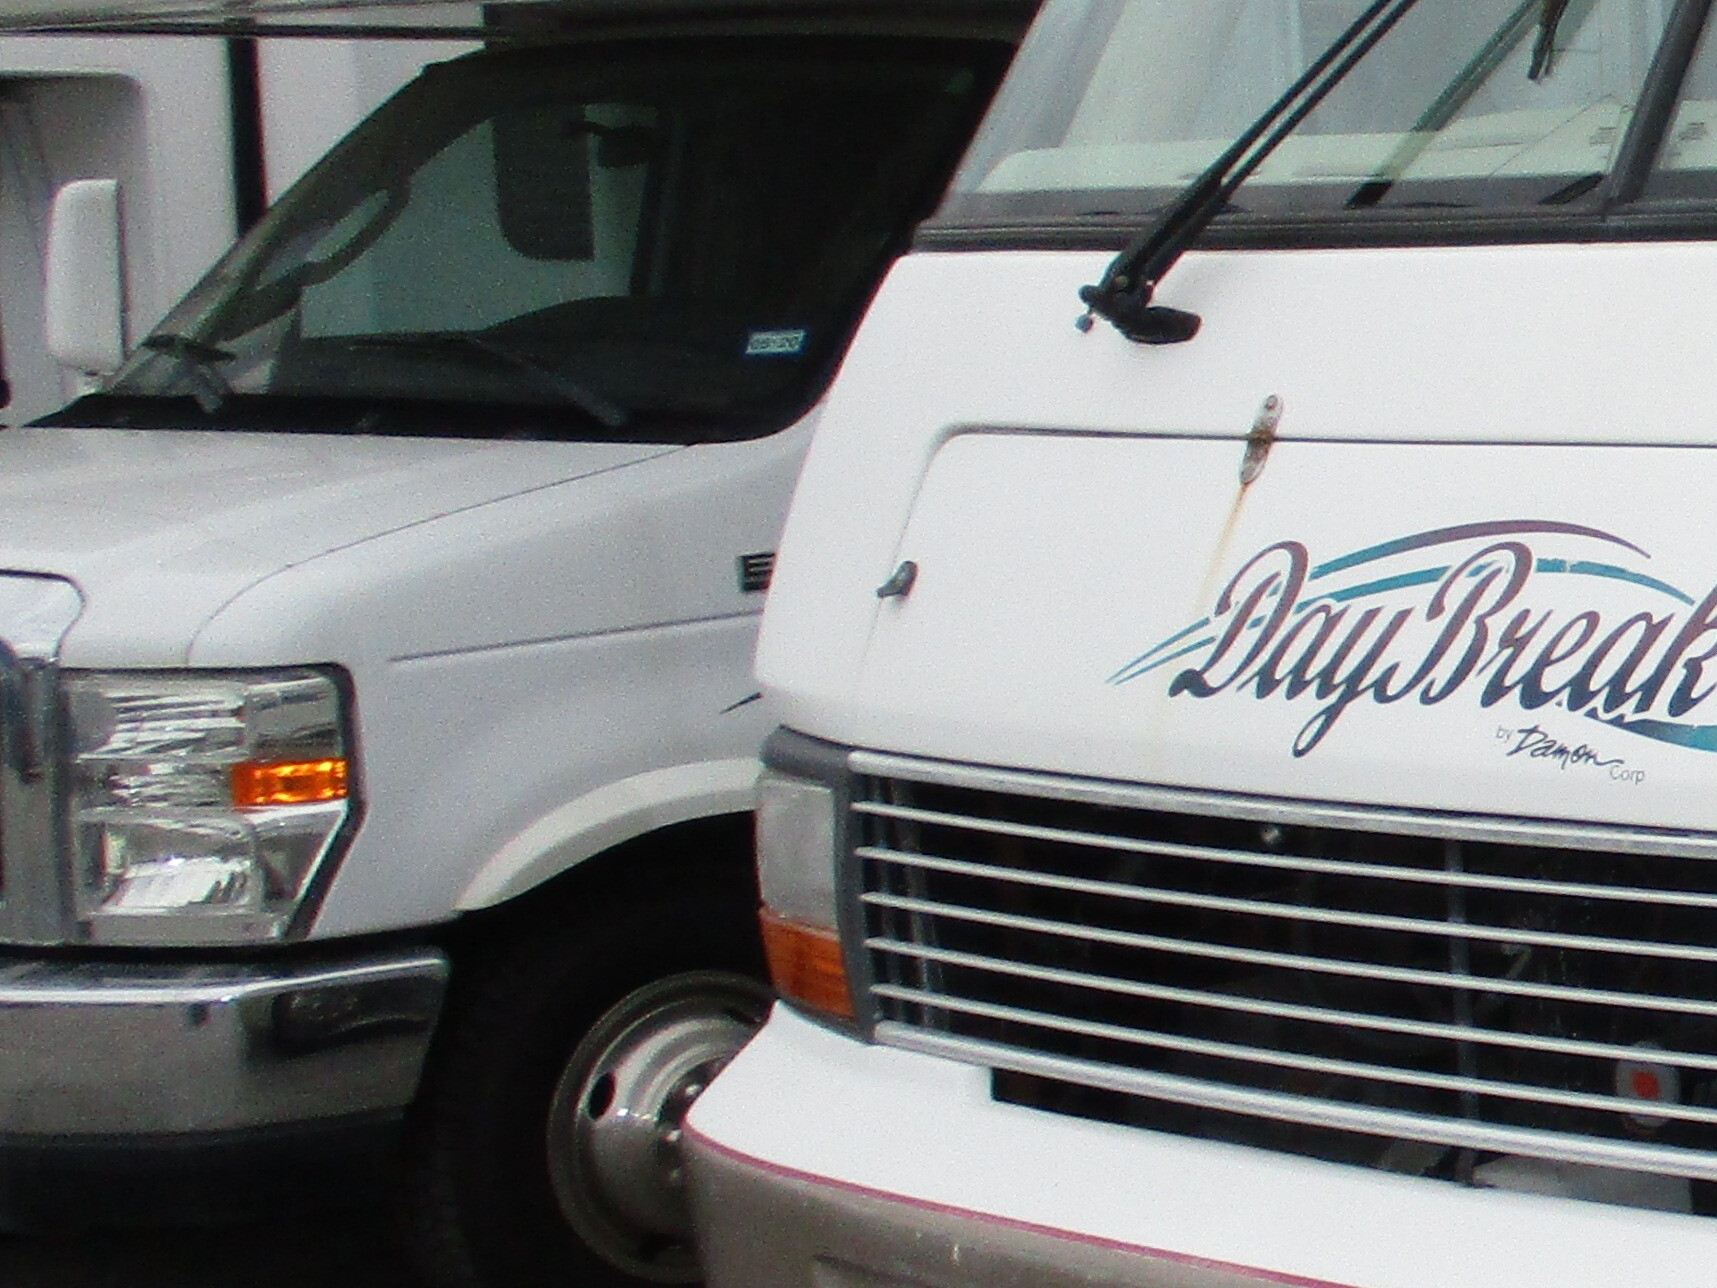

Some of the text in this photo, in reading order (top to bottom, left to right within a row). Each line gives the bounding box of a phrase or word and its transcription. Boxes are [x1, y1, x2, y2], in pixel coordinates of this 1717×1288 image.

[1496, 724, 1646, 786] by Damon Corp
